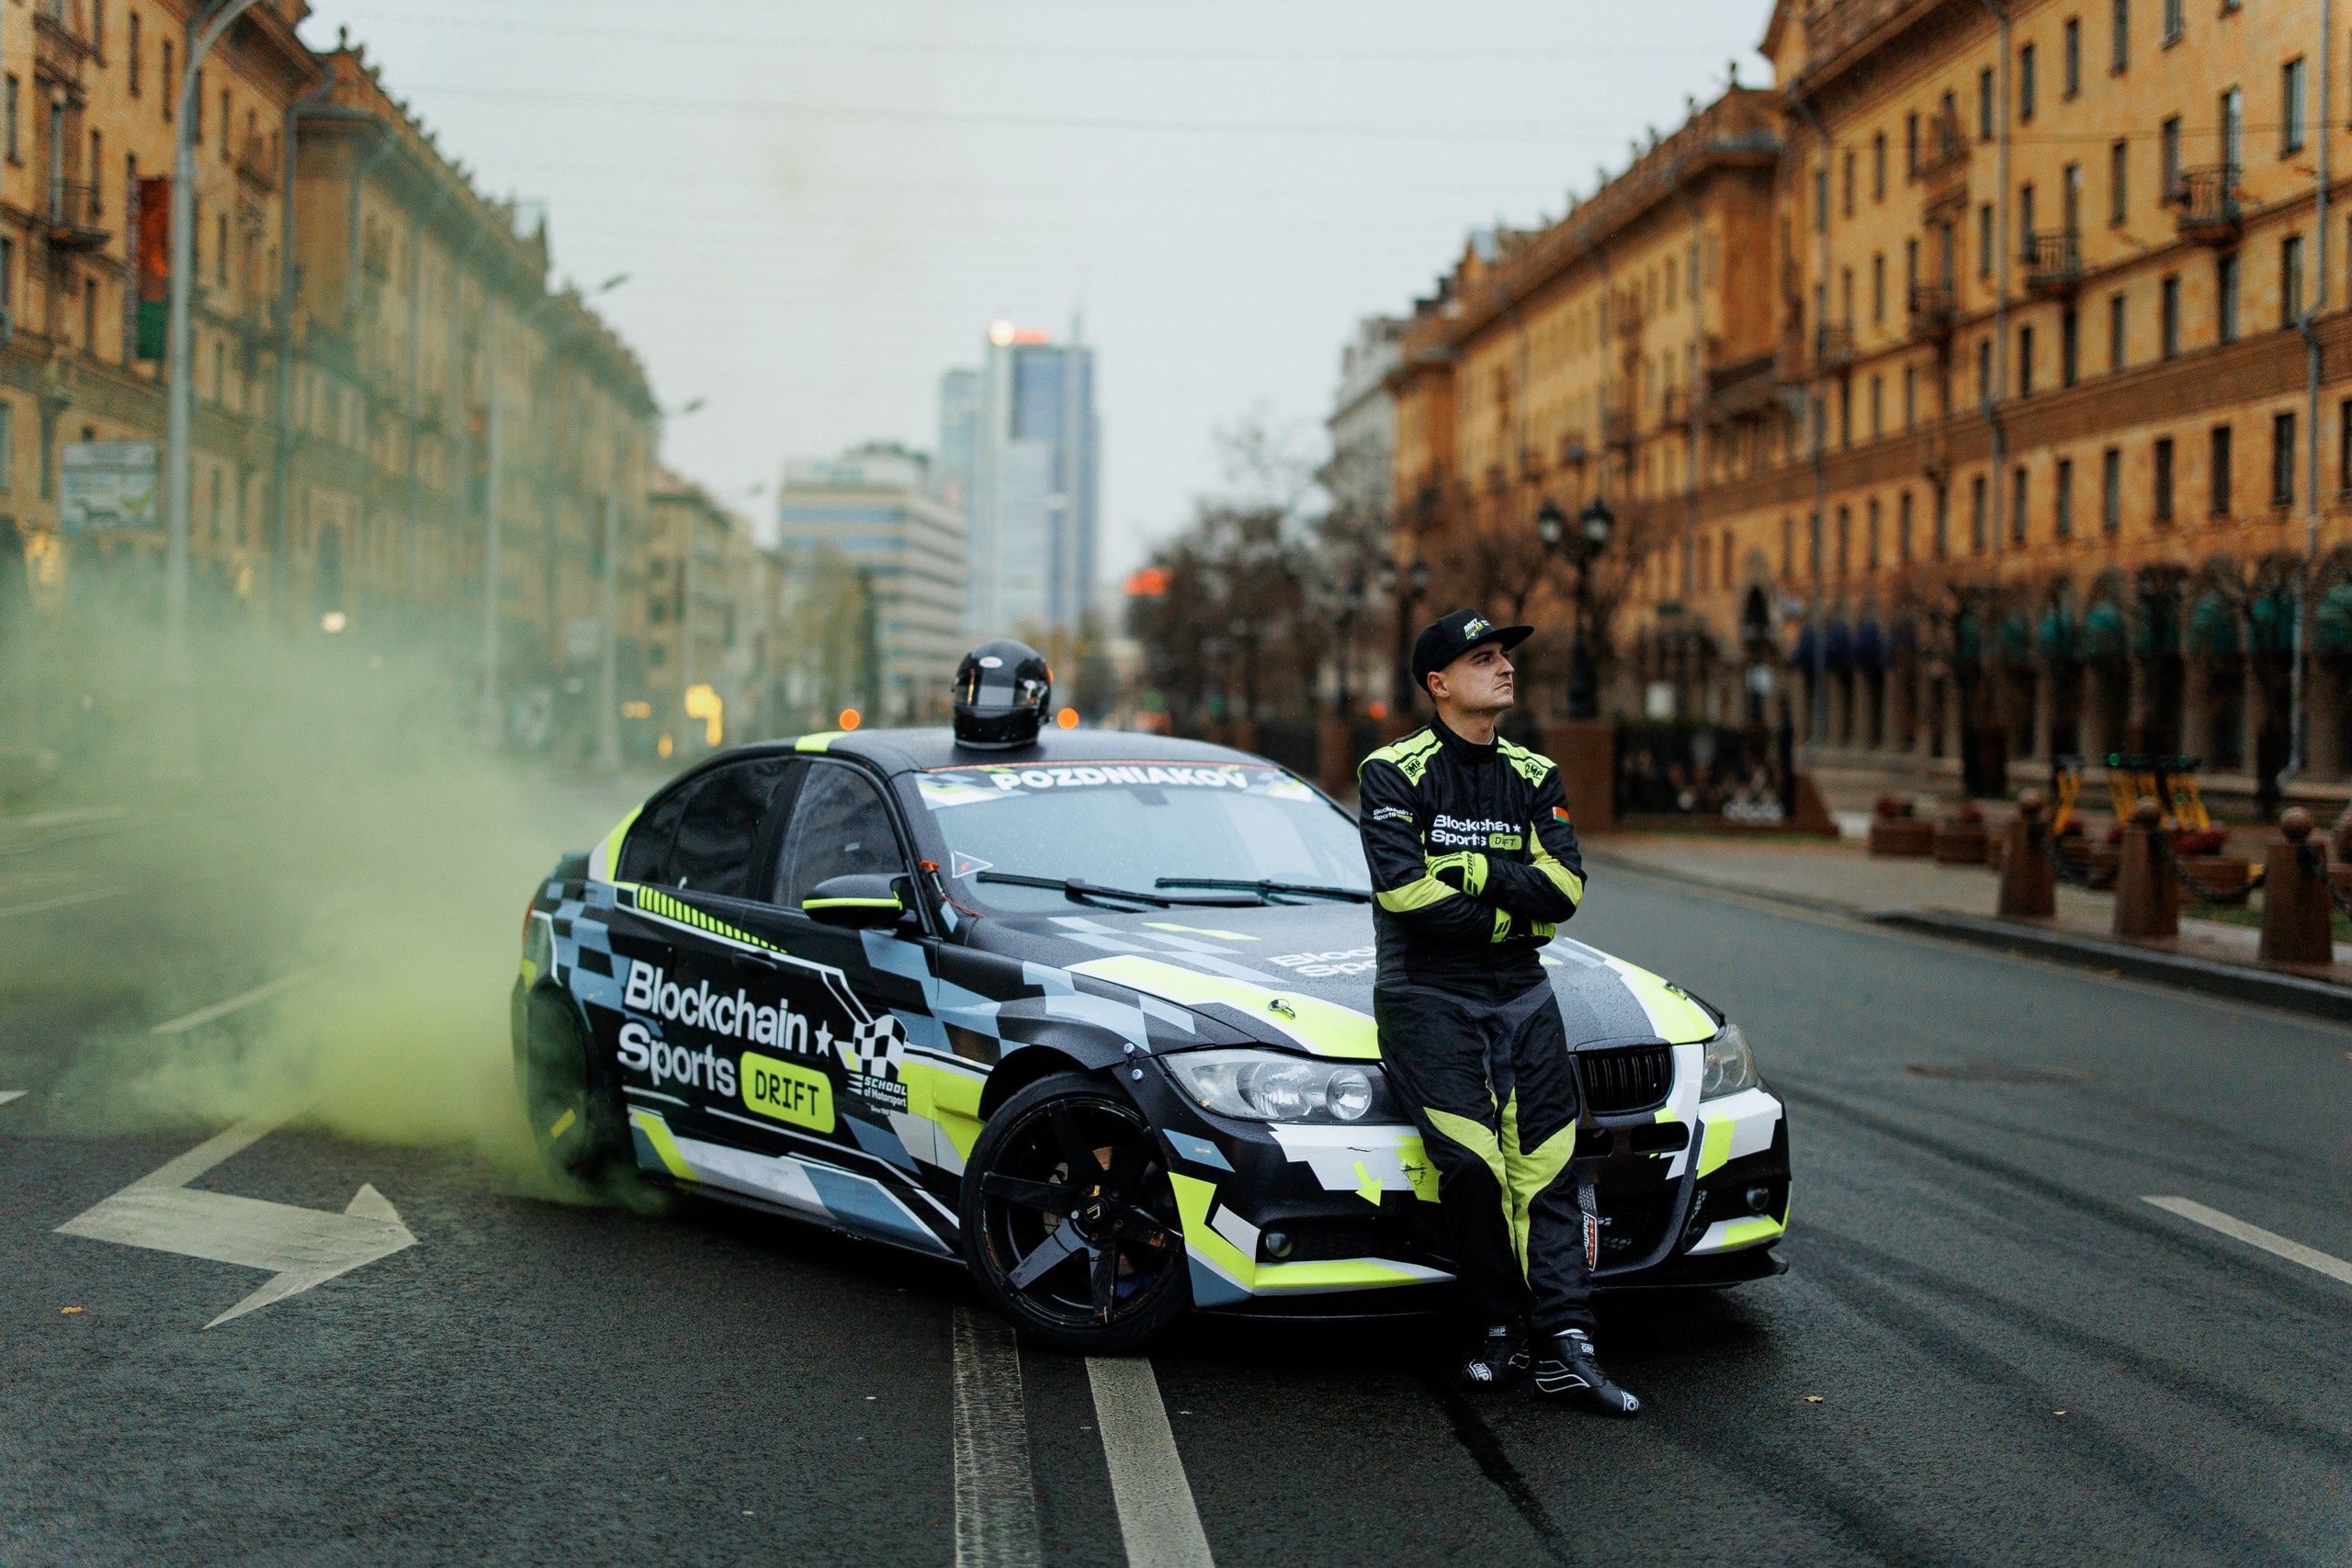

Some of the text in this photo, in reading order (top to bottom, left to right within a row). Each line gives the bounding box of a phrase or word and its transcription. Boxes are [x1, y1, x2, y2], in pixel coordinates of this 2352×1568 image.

[1406, 760, 1420, 775] OMP
[1525, 763, 1544, 777] OMP
[989, 766, 1248, 792] POZDNIAKOV
[1433, 815, 1510, 832] Blockchan
[1431, 829, 1487, 846] Sports
[625, 959, 808, 1055] Blockchain
[617, 1022, 820, 1116] Sports DRIFT
[864, 1076, 907, 1096] SCHOOL
[872, 1088, 907, 1108] Motorsport
[1473, 1363, 1489, 1381] OMP
